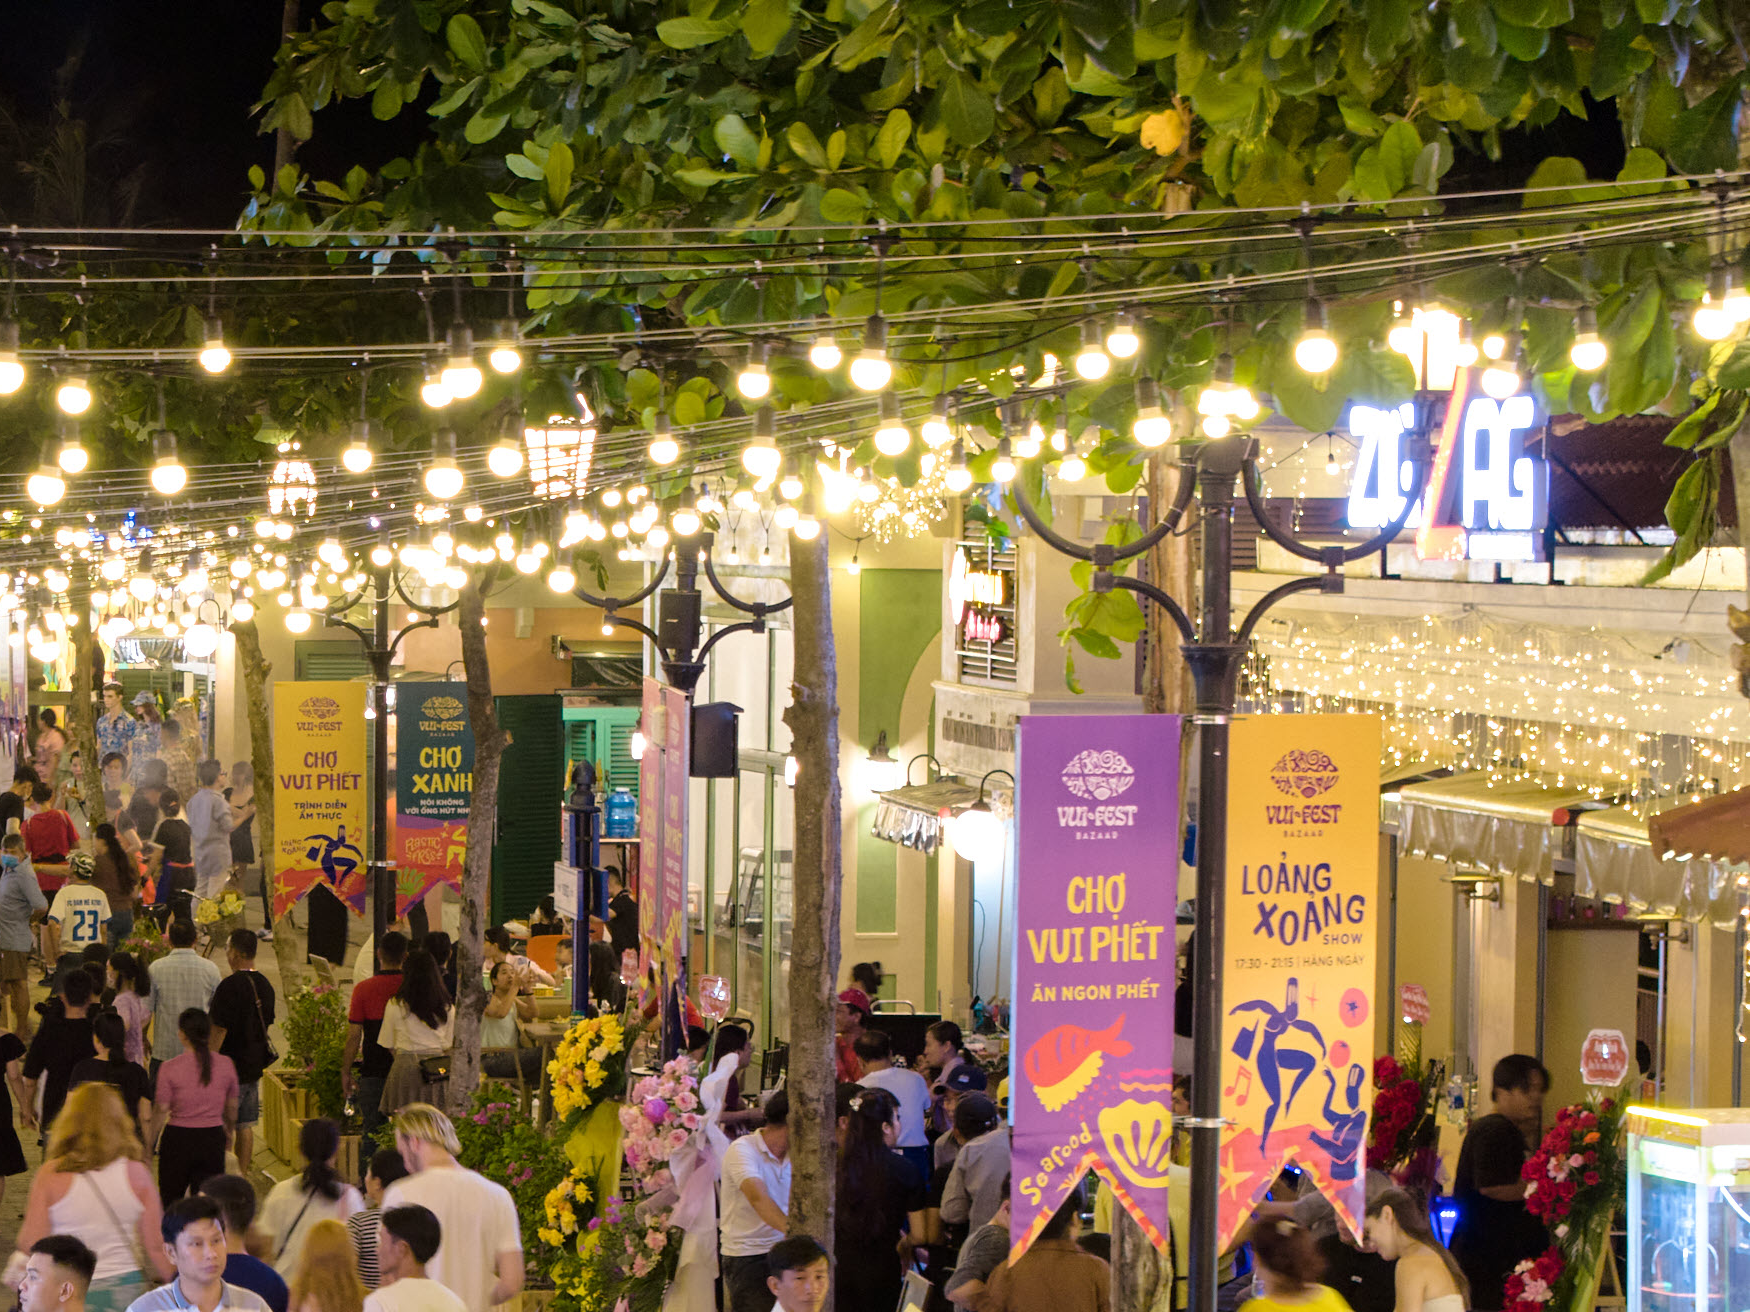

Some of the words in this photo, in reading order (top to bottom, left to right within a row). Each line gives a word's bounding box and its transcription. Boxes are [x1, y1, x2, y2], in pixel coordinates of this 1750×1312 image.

[304, 750, 337, 771] CHỢ
[419, 745, 462, 772] CHỢ
[280, 774, 312, 790] VUI
[317, 771, 361, 790] PHẾT
[412, 773, 472, 794] XANH
[1242, 851, 1332, 895] LOẢNG
[1066, 872, 1127, 921] CHỢ
[72, 909, 99, 942] 23
[1253, 890, 1366, 947] XOẢNG
[1026, 926, 1085, 964] VUI
[1090, 919, 1165, 962] PHẾT
[1322, 933, 1363, 945] SHOW
[1031, 983, 1057, 1002] ĂN
[1061, 985, 1112, 1001] NGON
[1116, 977, 1161, 999] PHẾT
[1019, 1121, 1093, 1206] Seafood
